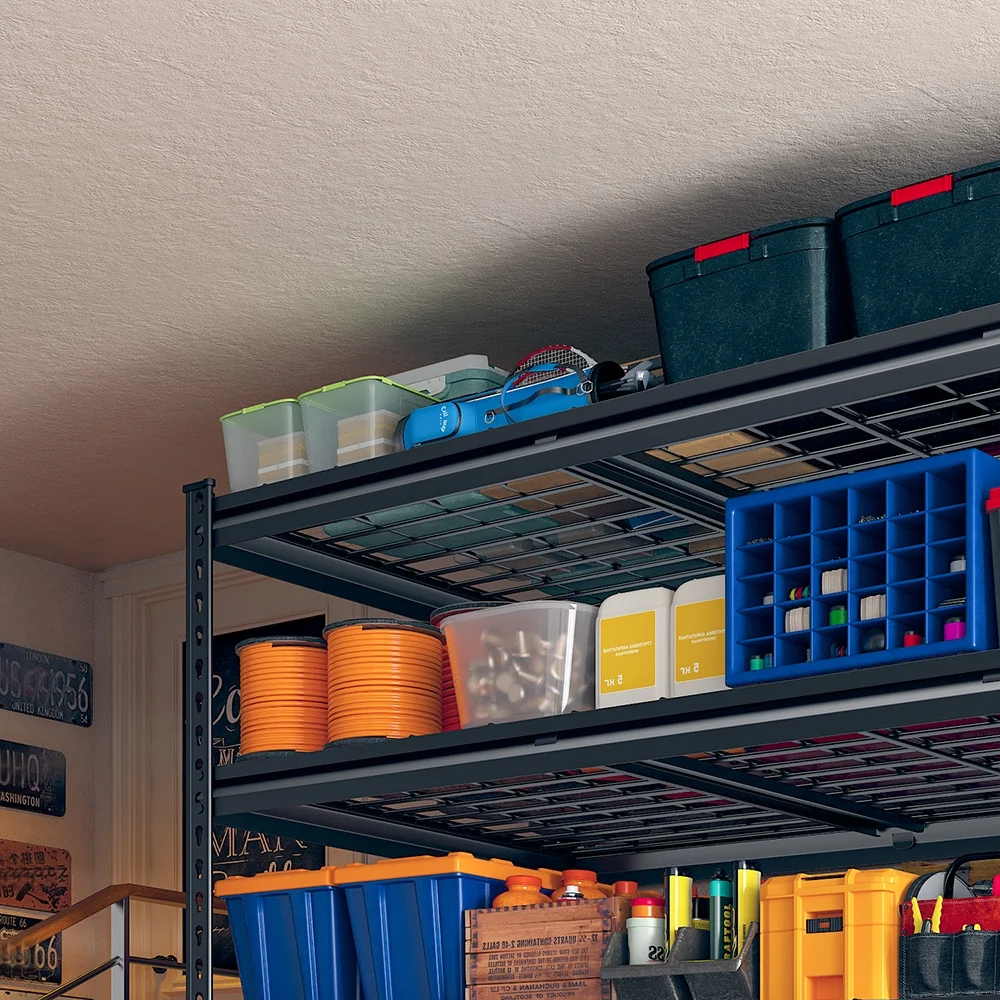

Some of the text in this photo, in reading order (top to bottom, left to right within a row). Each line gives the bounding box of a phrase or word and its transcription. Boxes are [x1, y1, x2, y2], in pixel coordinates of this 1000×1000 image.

[12, 702, 34, 714] UNITED
[0, 792, 40, 808] ASHINGTON
[19, 918, 27, 928] 66
[724, 904, 732, 959] RAFTOOL
